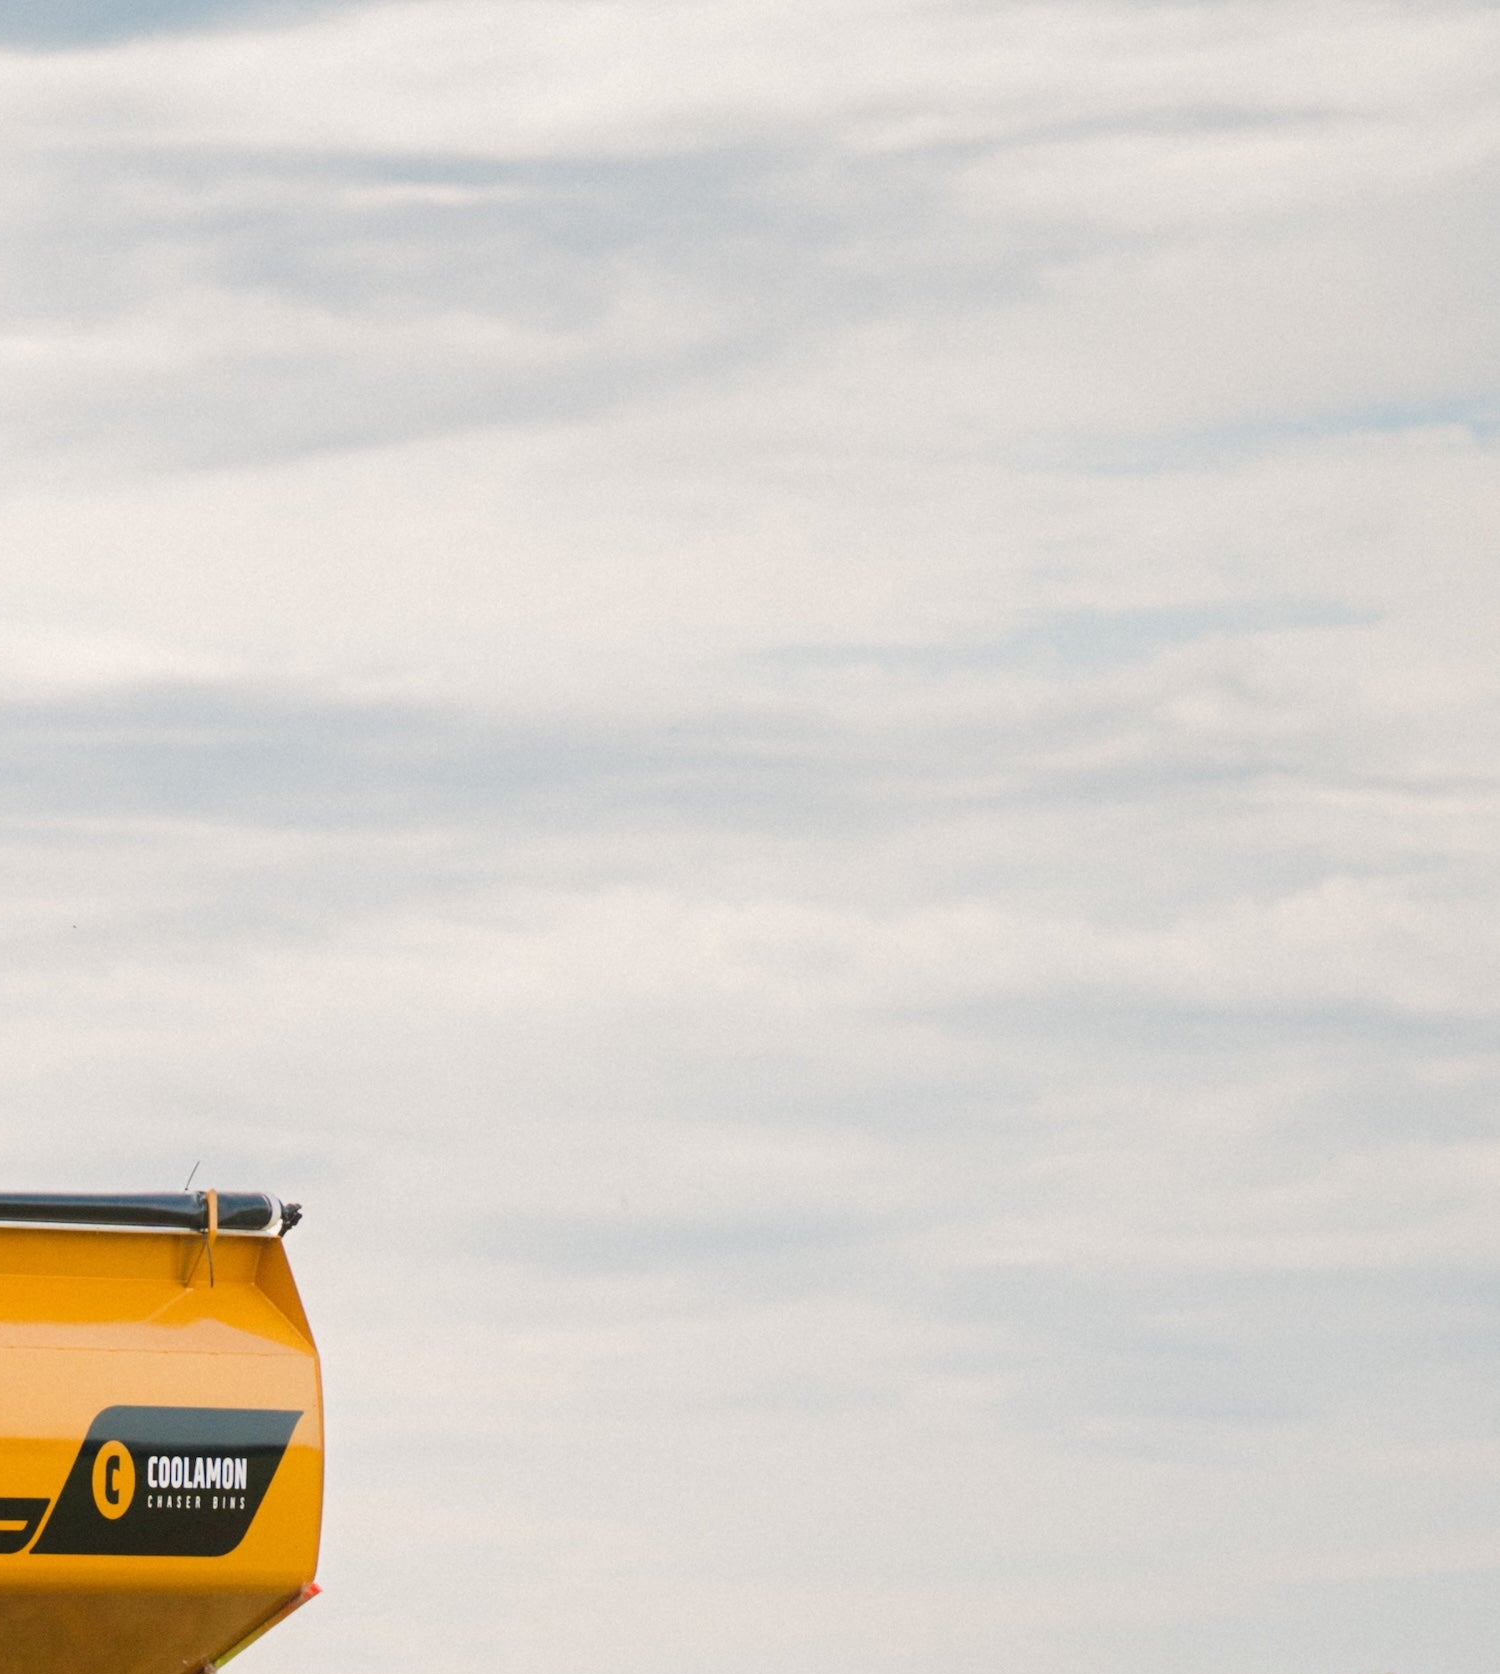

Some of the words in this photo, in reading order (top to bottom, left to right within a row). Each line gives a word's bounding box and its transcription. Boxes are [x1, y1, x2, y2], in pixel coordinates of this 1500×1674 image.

[147, 1456, 248, 1489] COOLAMON
[147, 1495, 201, 1509] CHASER
[212, 1496, 246, 1510] BINS
